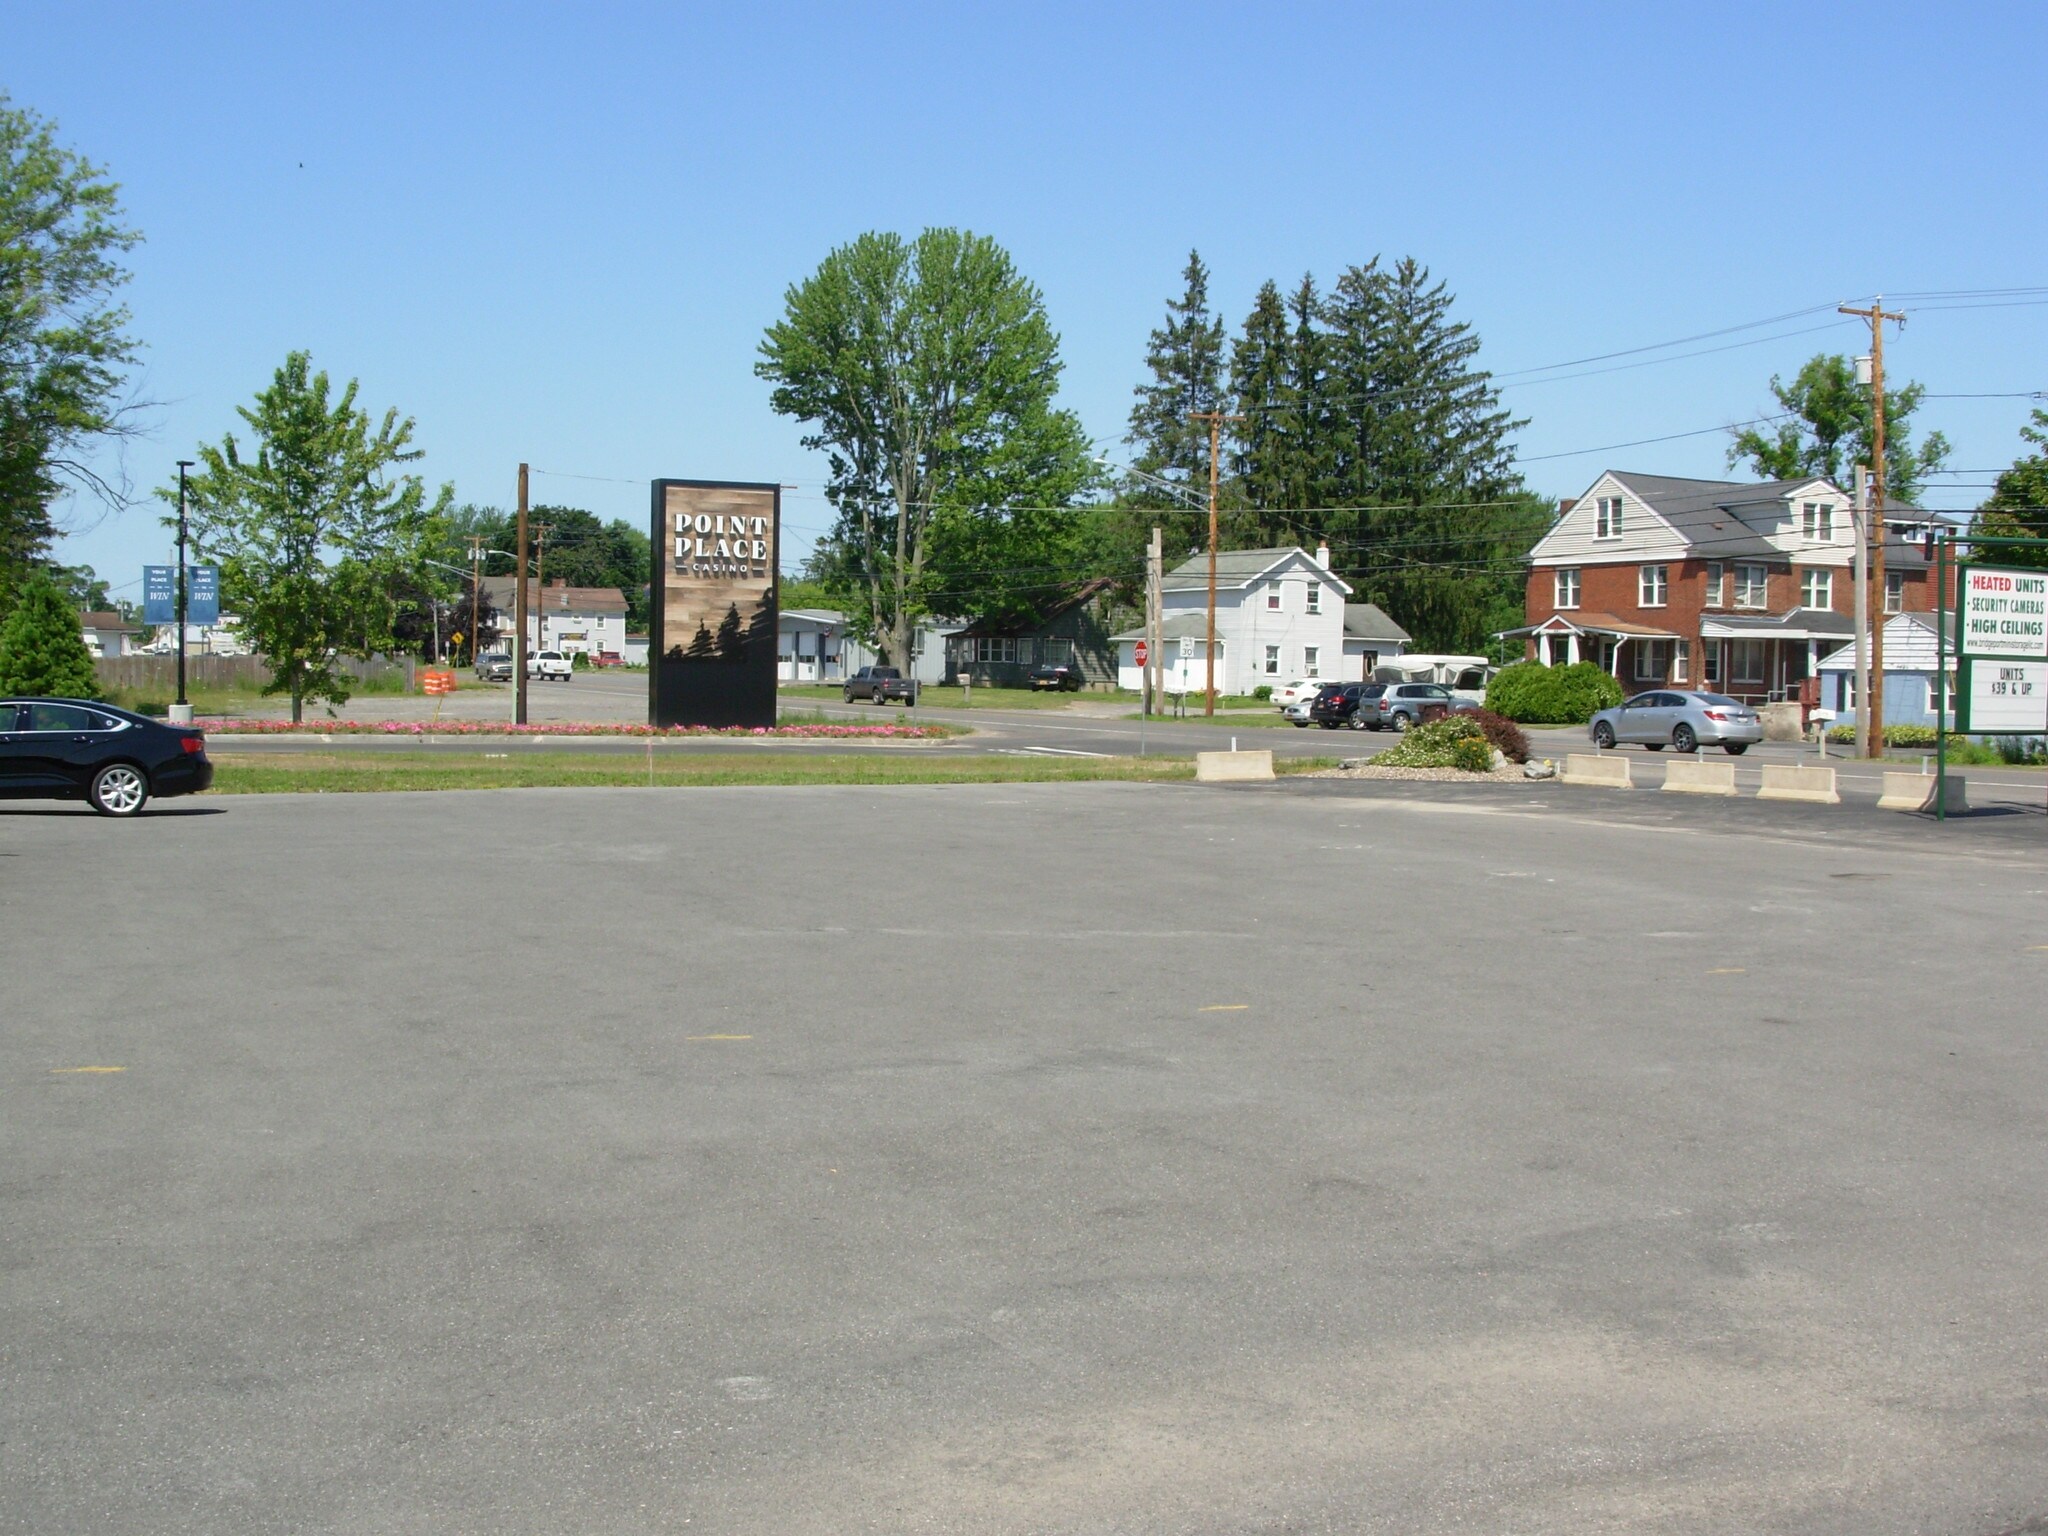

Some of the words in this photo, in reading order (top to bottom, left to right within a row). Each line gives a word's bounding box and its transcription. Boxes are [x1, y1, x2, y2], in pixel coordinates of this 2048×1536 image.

[675, 513, 767, 535] POINT
[675, 537, 767, 560] PLACE
[692, 563, 748, 572] CASINO
[1972, 575, 2012, 591] HEATED
[2015, 578, 2045, 594] UNITS
[150, 592, 170, 600] WIN
[194, 592, 214, 601] WIN
[1972, 597, 2008, 613] SECURITY
[2010, 600, 2044, 615] CAMERAS
[1971, 619, 1997, 634] HIGH
[2000, 620, 2043, 635] CEILINGS
[1135, 648, 1147, 659] STOP
[1181, 648, 1193, 656] 30
[2000, 668, 2024, 681] UNITS
[1992, 682, 2007, 695] $39
[2011, 682, 2017, 695] &
[2021, 683, 2032, 695] UP
